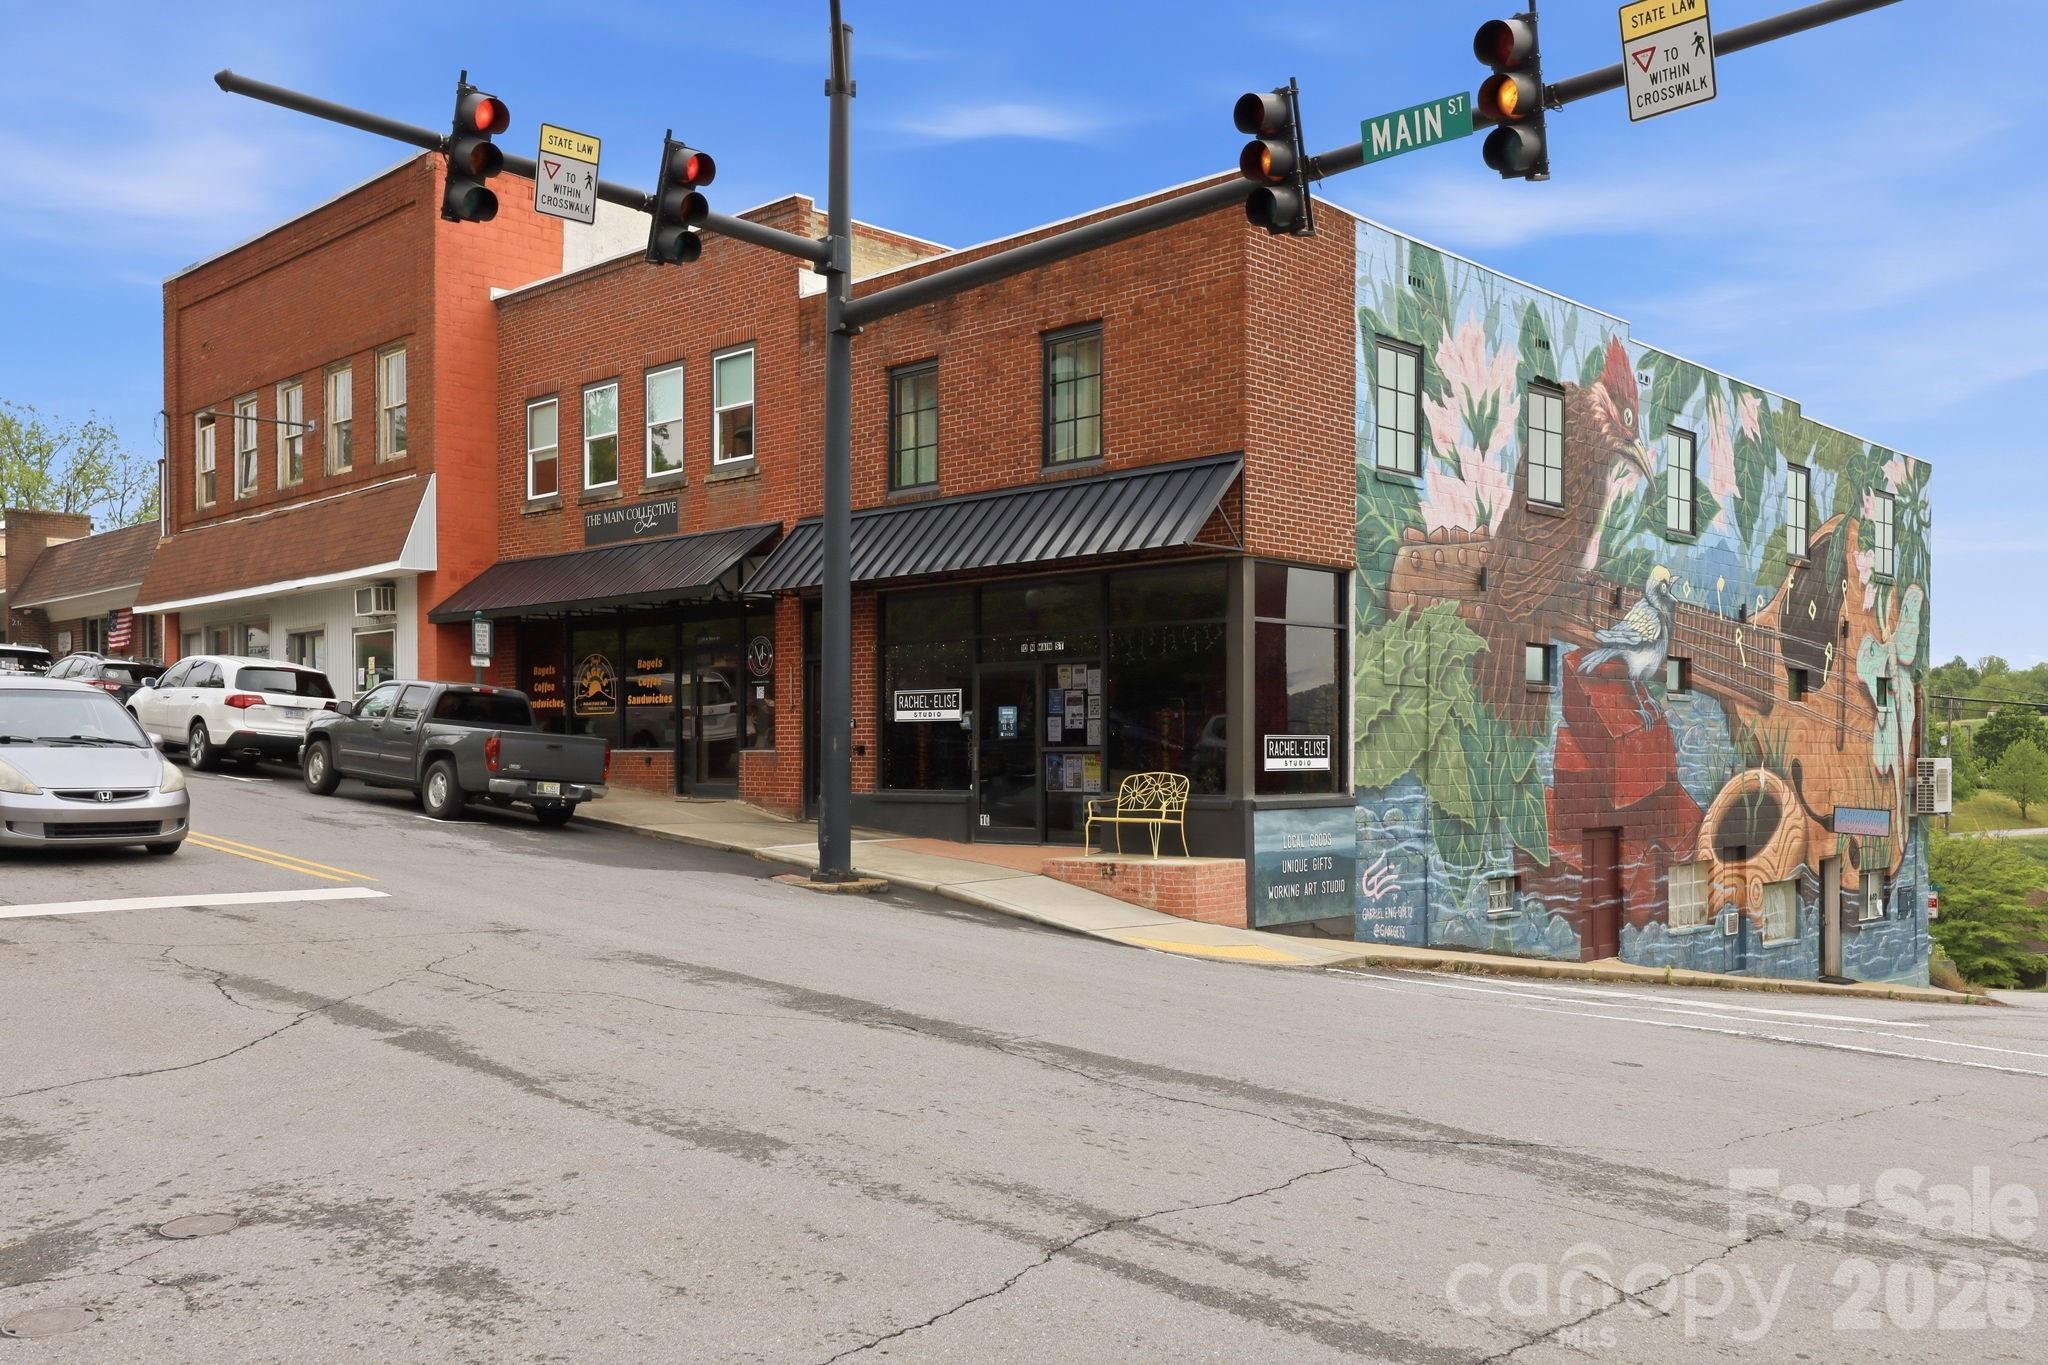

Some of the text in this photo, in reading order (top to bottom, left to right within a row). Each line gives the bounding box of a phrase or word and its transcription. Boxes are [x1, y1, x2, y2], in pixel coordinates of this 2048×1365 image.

[1631, 0, 1696, 29] STATE LAW
[1663, 46, 1679, 62] TO
[1649, 62, 1690, 86] WITHIN
[1636, 75, 1708, 108] CROSSWALK
[1371, 96, 1463, 156] MAIN ST
[548, 135, 593, 156] STATE LAW
[566, 172, 576, 184] TO
[553, 183, 581, 199] WITHIN
[541, 194, 590, 215] CROSSWALK
[585, 501, 677, 528] THE MAIN COLLECTIVE
[1055, 641, 1064, 651] ST
[533, 664, 556, 677] Bagels
[637, 657, 663, 671] Bagels
[533, 682, 556, 694] Coffee
[638, 676, 662, 689] Coffee
[627, 693, 673, 706] Sandwiches
[980, 814, 990, 826] 10
[1283, 833, 1332, 849] LOCAL GOODS
[1282, 856, 1333, 874] UNIQUE GIFTS
[1268, 879, 1345, 900] WORKING ART STUDIO
[1362, 907, 1384, 920] GABRIEL
